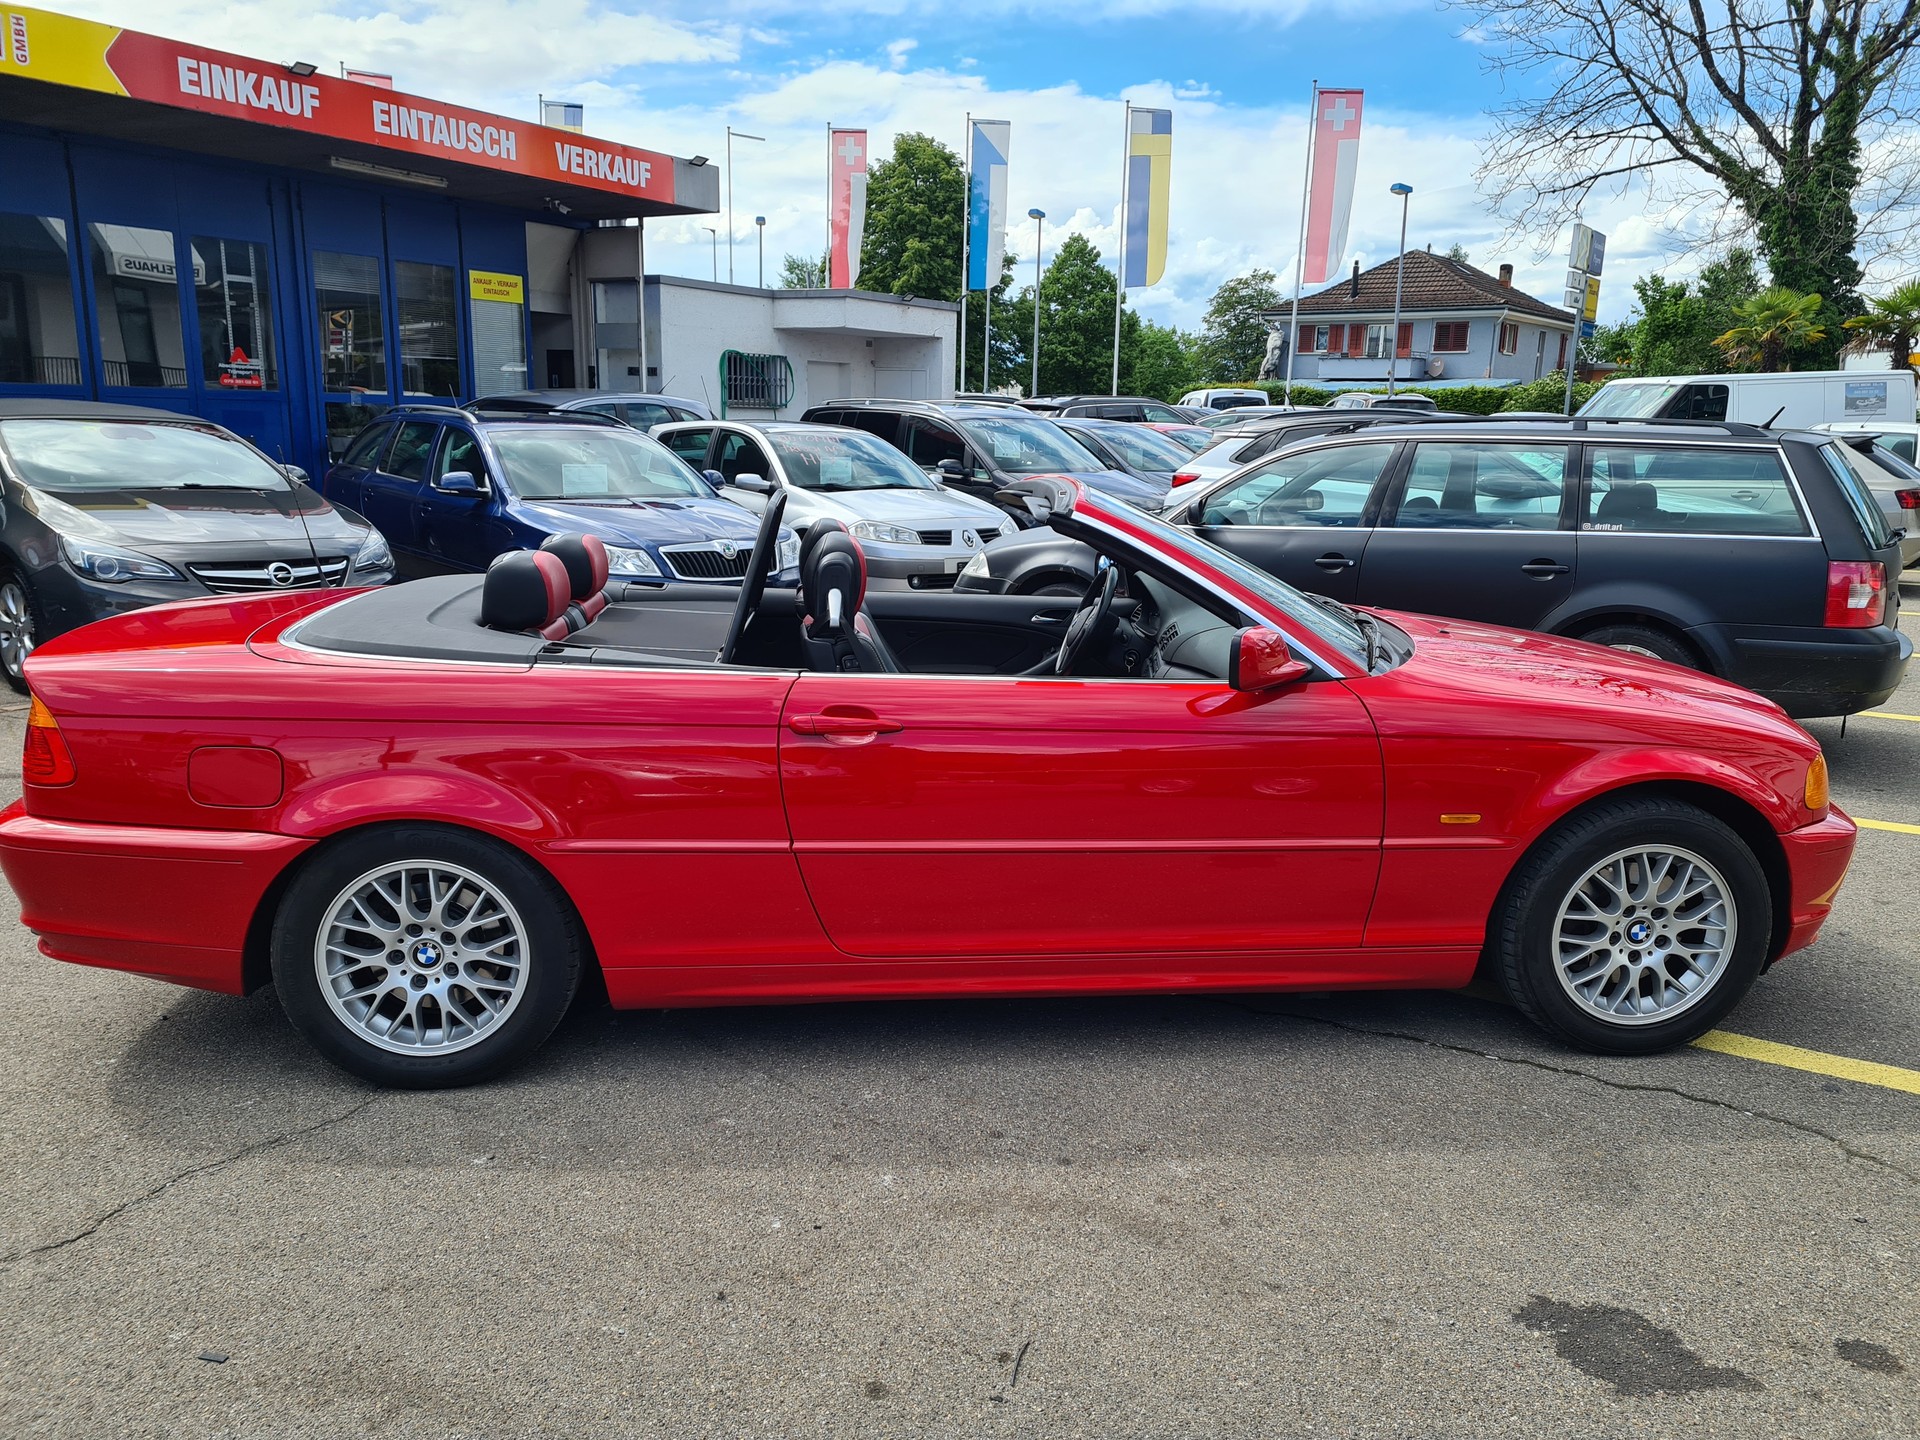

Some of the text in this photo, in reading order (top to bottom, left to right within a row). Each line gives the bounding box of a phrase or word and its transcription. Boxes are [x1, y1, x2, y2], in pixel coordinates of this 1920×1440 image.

[10, 14, 28, 64] GMBH
[177, 56, 652, 188] EINKAUF EINTAUSCH VERKAUF
[497, 280, 518, 288] VERKAUF
[484, 288, 510, 296] EINTAUSCH
[417, 942, 440, 954] BMW
